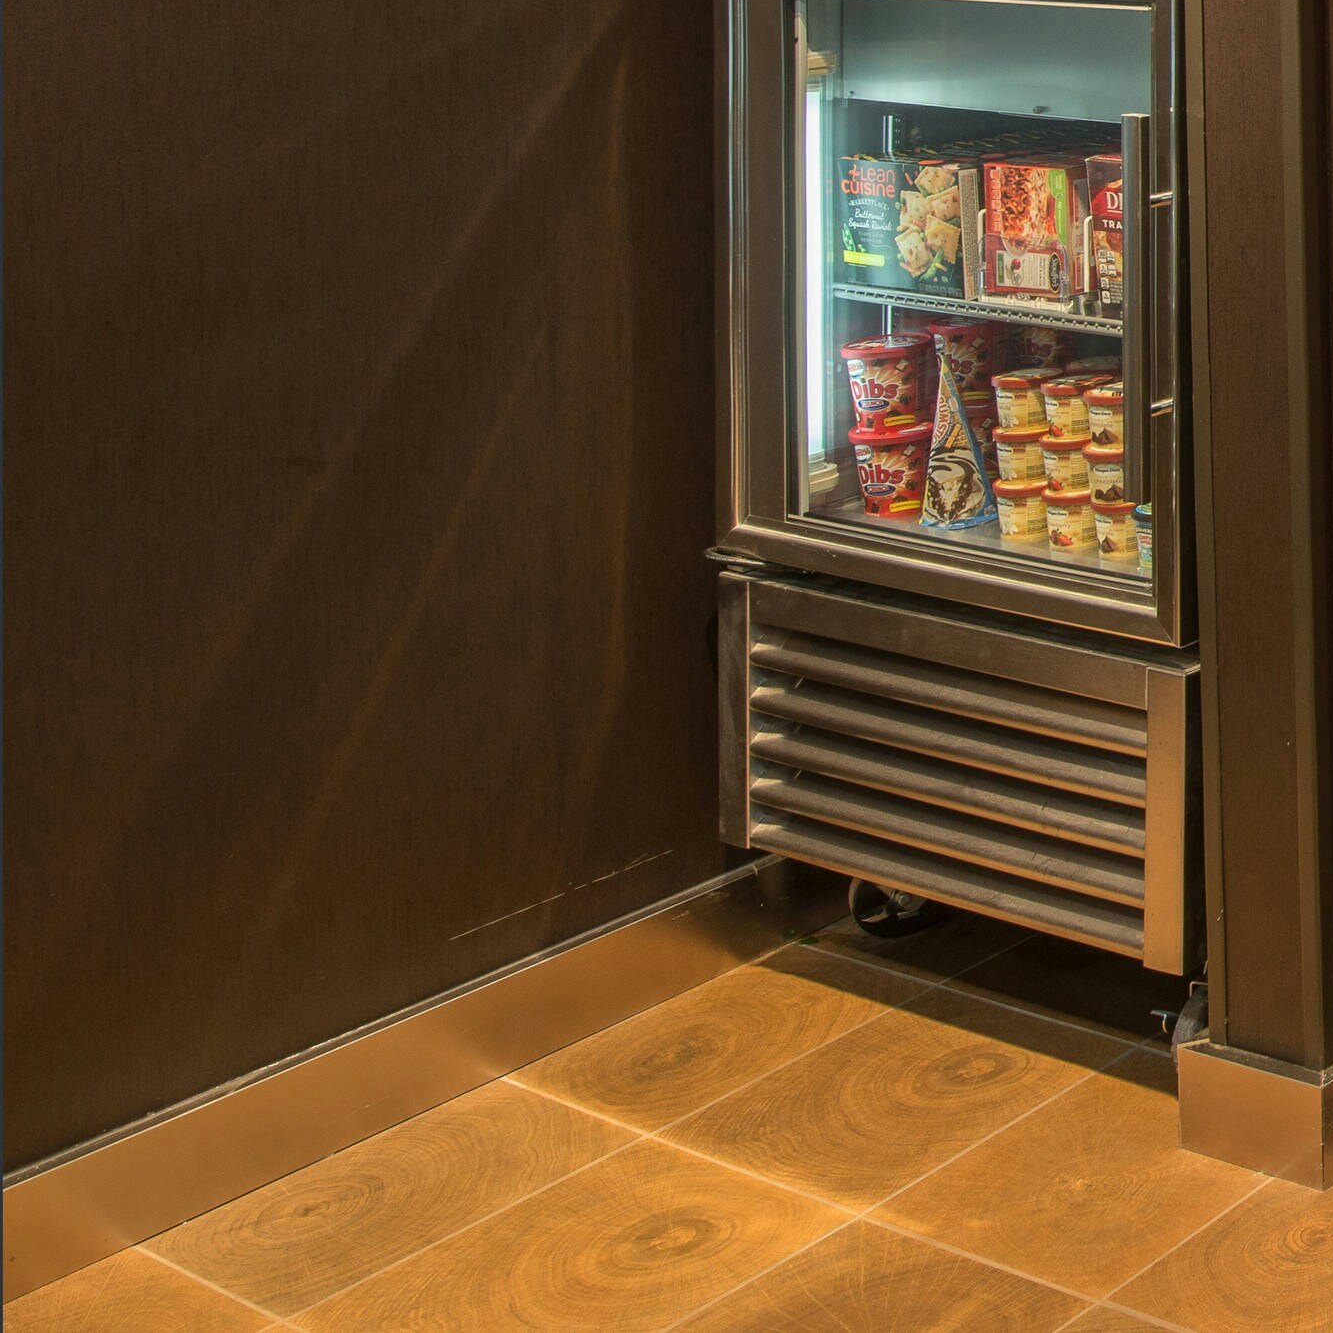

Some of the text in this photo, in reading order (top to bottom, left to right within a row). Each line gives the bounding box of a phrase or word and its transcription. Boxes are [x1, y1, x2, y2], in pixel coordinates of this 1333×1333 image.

[860, 167, 895, 183] Lean
[851, 380, 900, 400] Dibs
[857, 464, 906, 484] Dibs
